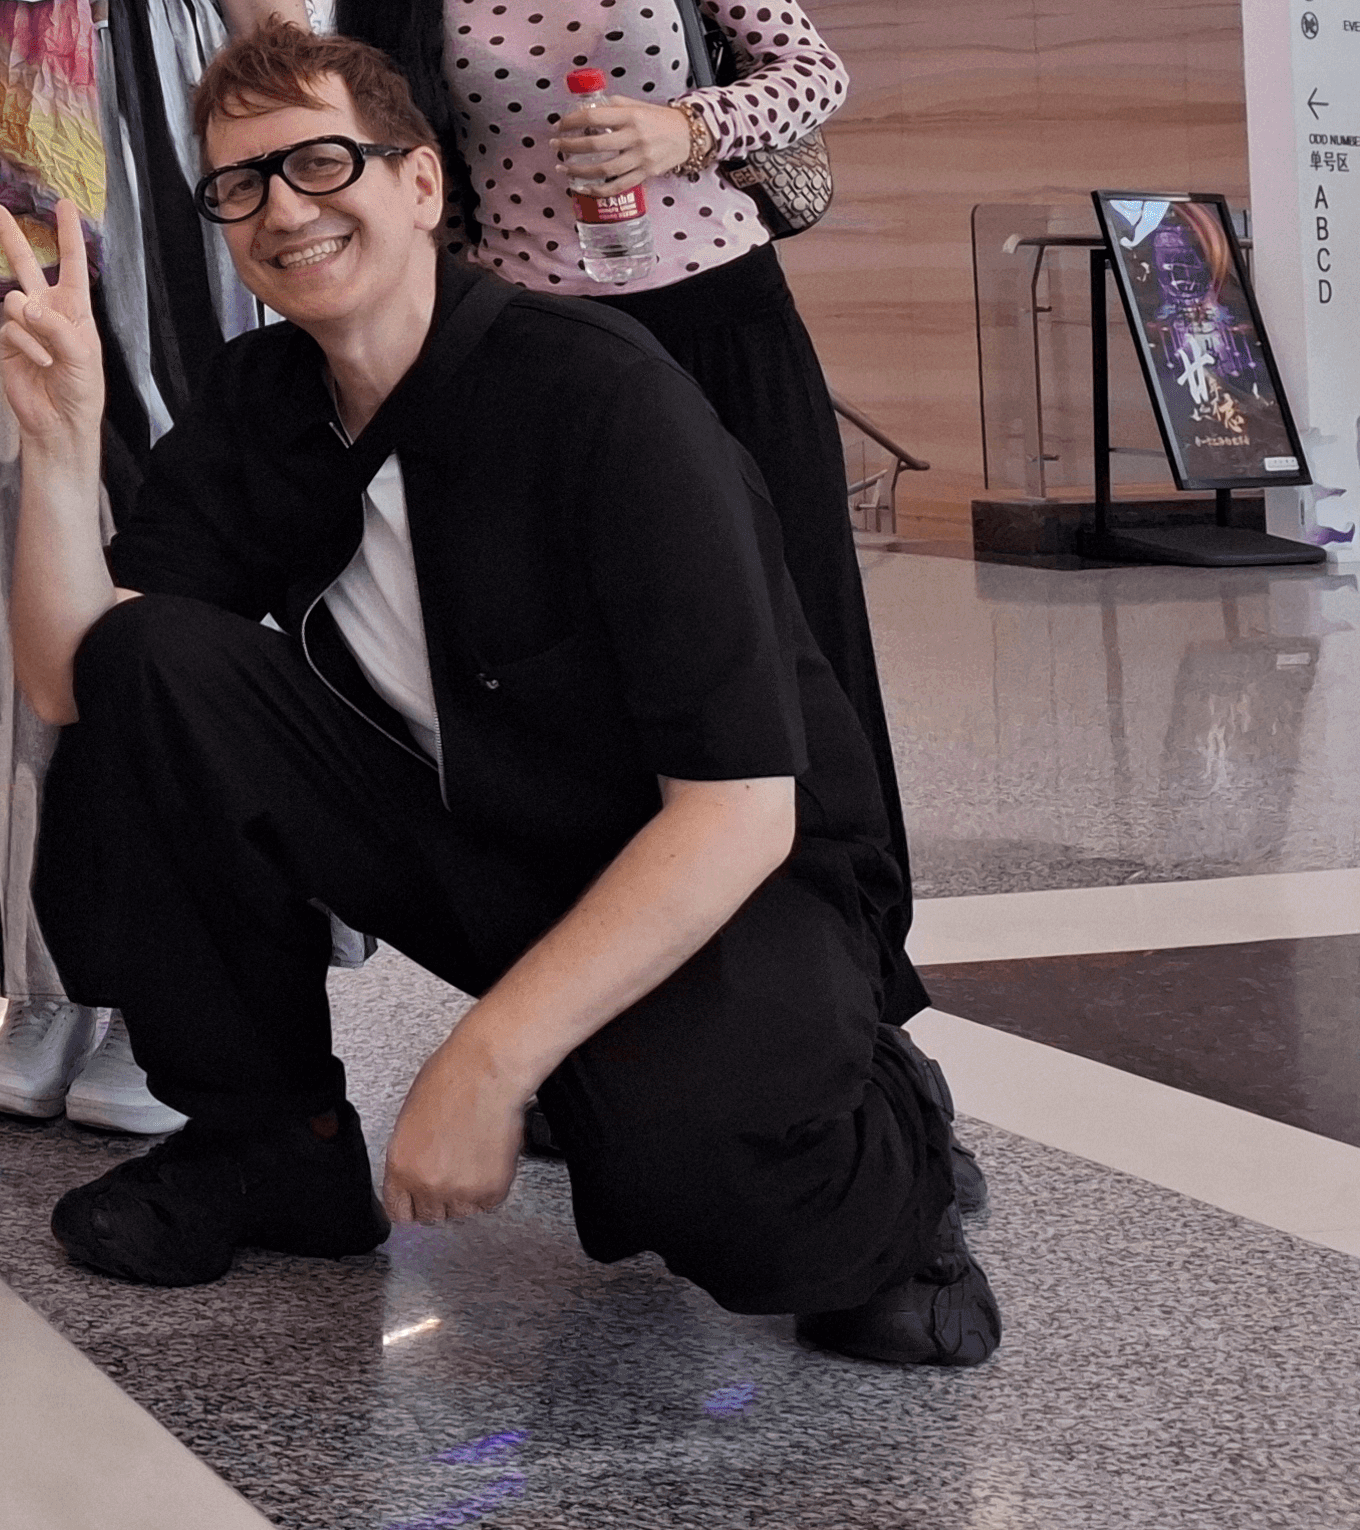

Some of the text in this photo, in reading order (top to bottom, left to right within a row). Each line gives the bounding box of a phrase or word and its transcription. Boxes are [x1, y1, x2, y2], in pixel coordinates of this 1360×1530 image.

[1309, 150, 1349, 172] 单号区
[1314, 185, 1329, 209] A
[1316, 216, 1329, 241] B
[1317, 248, 1331, 272] C
[1319, 279, 1332, 304] D
